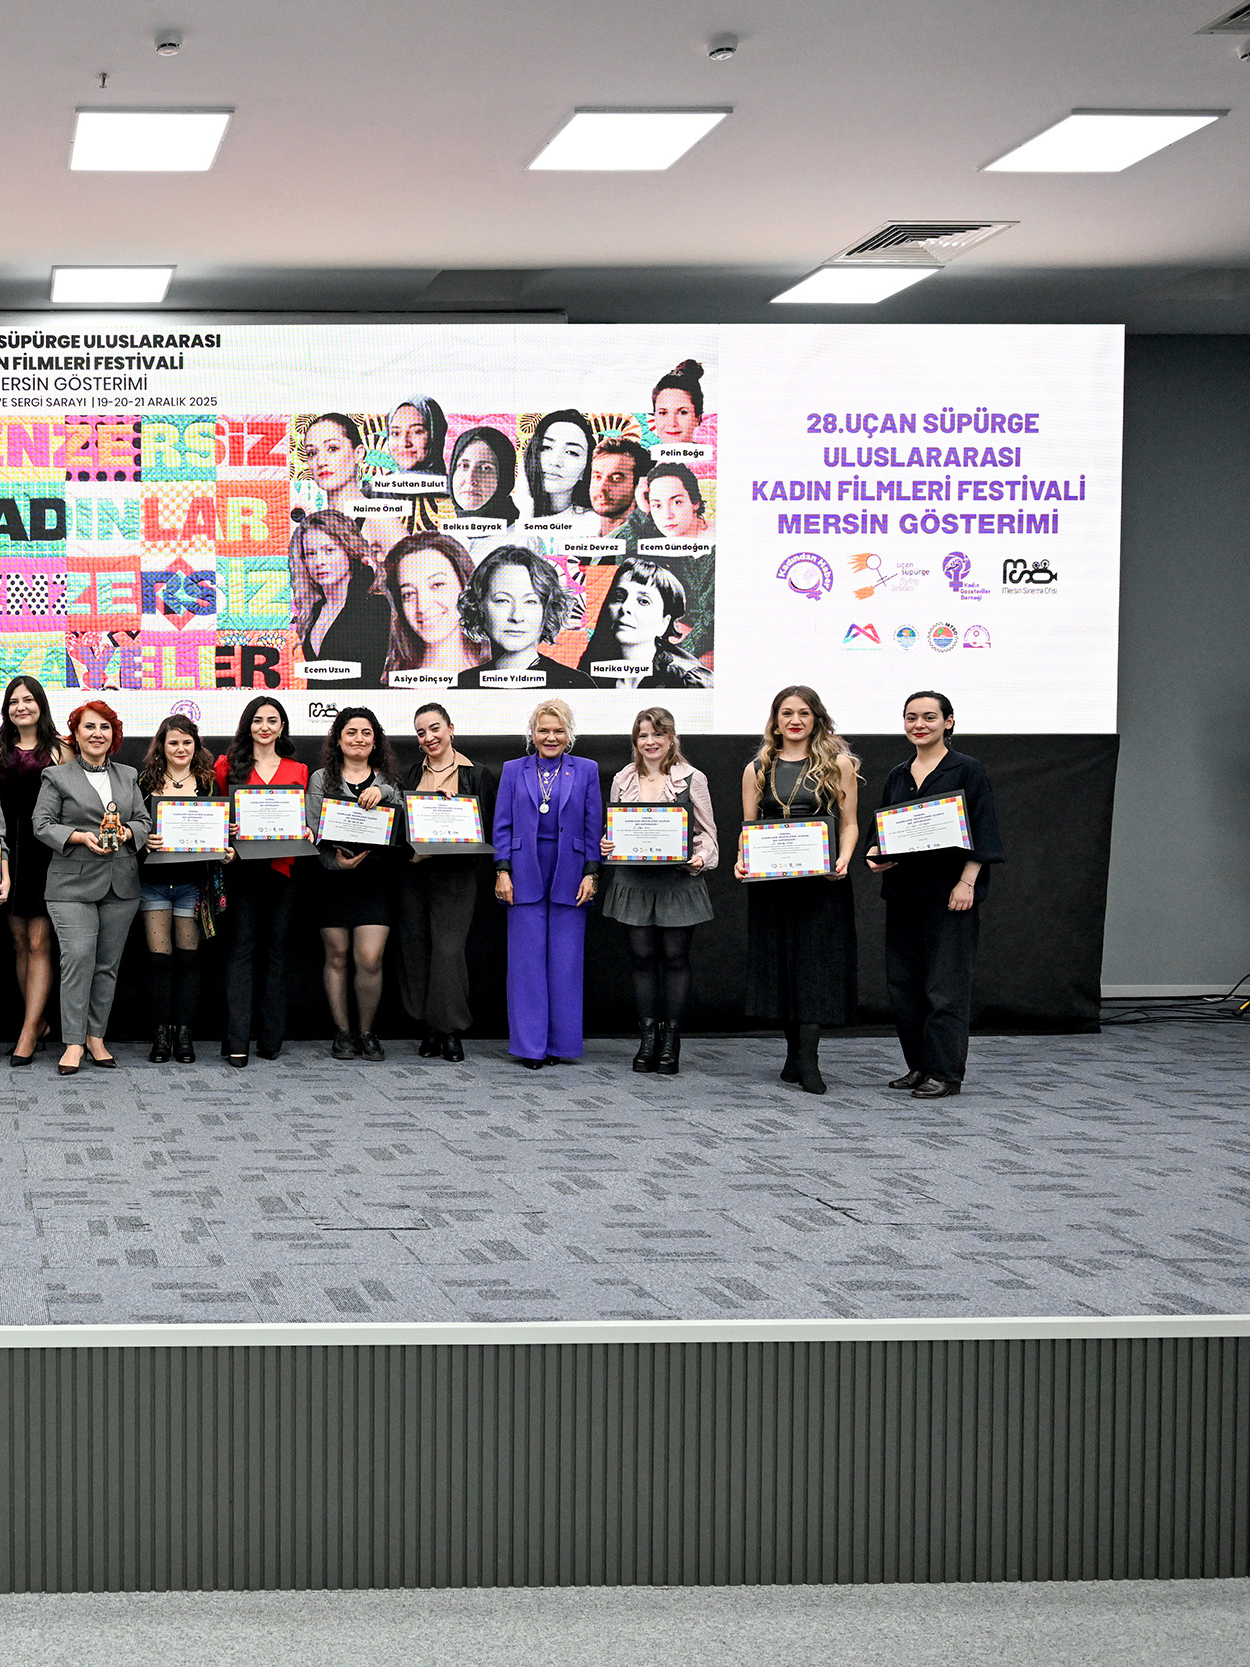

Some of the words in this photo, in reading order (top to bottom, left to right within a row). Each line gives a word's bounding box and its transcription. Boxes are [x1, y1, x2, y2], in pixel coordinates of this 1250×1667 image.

[84, 334, 221, 349] ULUSLARARASI
[13, 352, 91, 370] FİLMLERİ
[94, 351, 183, 370] FESTİVALİ
[53, 372, 147, 391] GÖSTERİMİ
[10, 395, 43, 407] SERGİ
[47, 398, 86, 407] SARAYI
[97, 397, 145, 407] 19-20-21
[148, 397, 187, 407] ARALIK
[189, 396, 218, 407] 2025
[806, 413, 917, 438] 28.UÇAN
[923, 407, 1039, 434] SÜPÜRGE
[682, 449, 705, 458] Boğa
[823, 447, 1021, 468] ULUSLARARASI
[752, 480, 831, 501] KADIN
[838, 475, 951, 501] FİLMLERİ
[957, 474, 1086, 501] FESTİVALİ
[382, 503, 403, 512] Önal
[550, 522, 572, 530] Güler
[778, 509, 889, 534] MERSİN
[899, 508, 1059, 534] GÖSTERİMİ
[471, 523, 502, 532] Bayrak
[664, 543, 710, 552] Gündoğan
[623, 665, 650, 674] Uygur
[394, 675, 418, 683] Asiye
[419, 675, 454, 684] Dinçsoy
